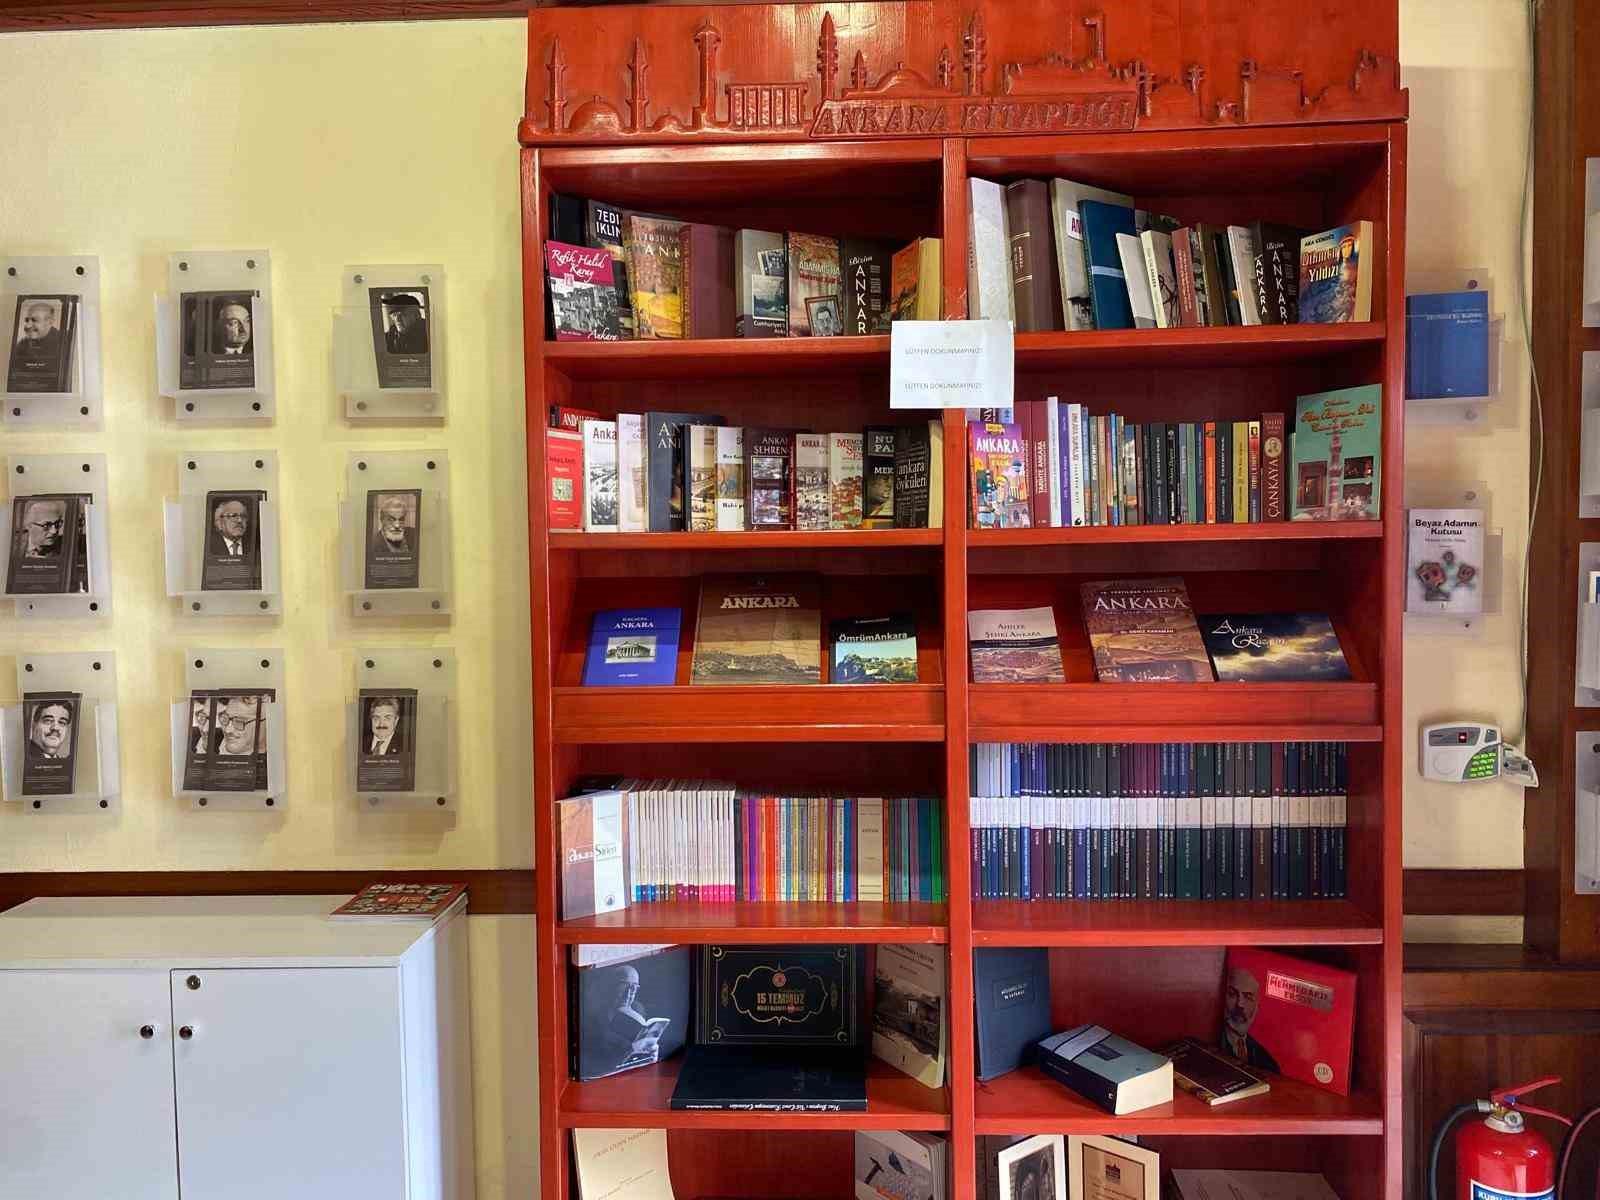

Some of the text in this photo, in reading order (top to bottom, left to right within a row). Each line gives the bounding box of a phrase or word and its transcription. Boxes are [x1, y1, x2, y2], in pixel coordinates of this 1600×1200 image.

[820, 102, 948, 134] ANKARA
[976, 438, 1020, 453] ANKARA
[1264, 457, 1281, 518] ÇANKAYA
[1415, 519, 1442, 528] Beyaz
[1431, 527, 1462, 535] Kutusu
[720, 596, 800, 609] ANKARA
[1094, 596, 1188, 611] ANKARA
[613, 621, 655, 629] ANKARA
